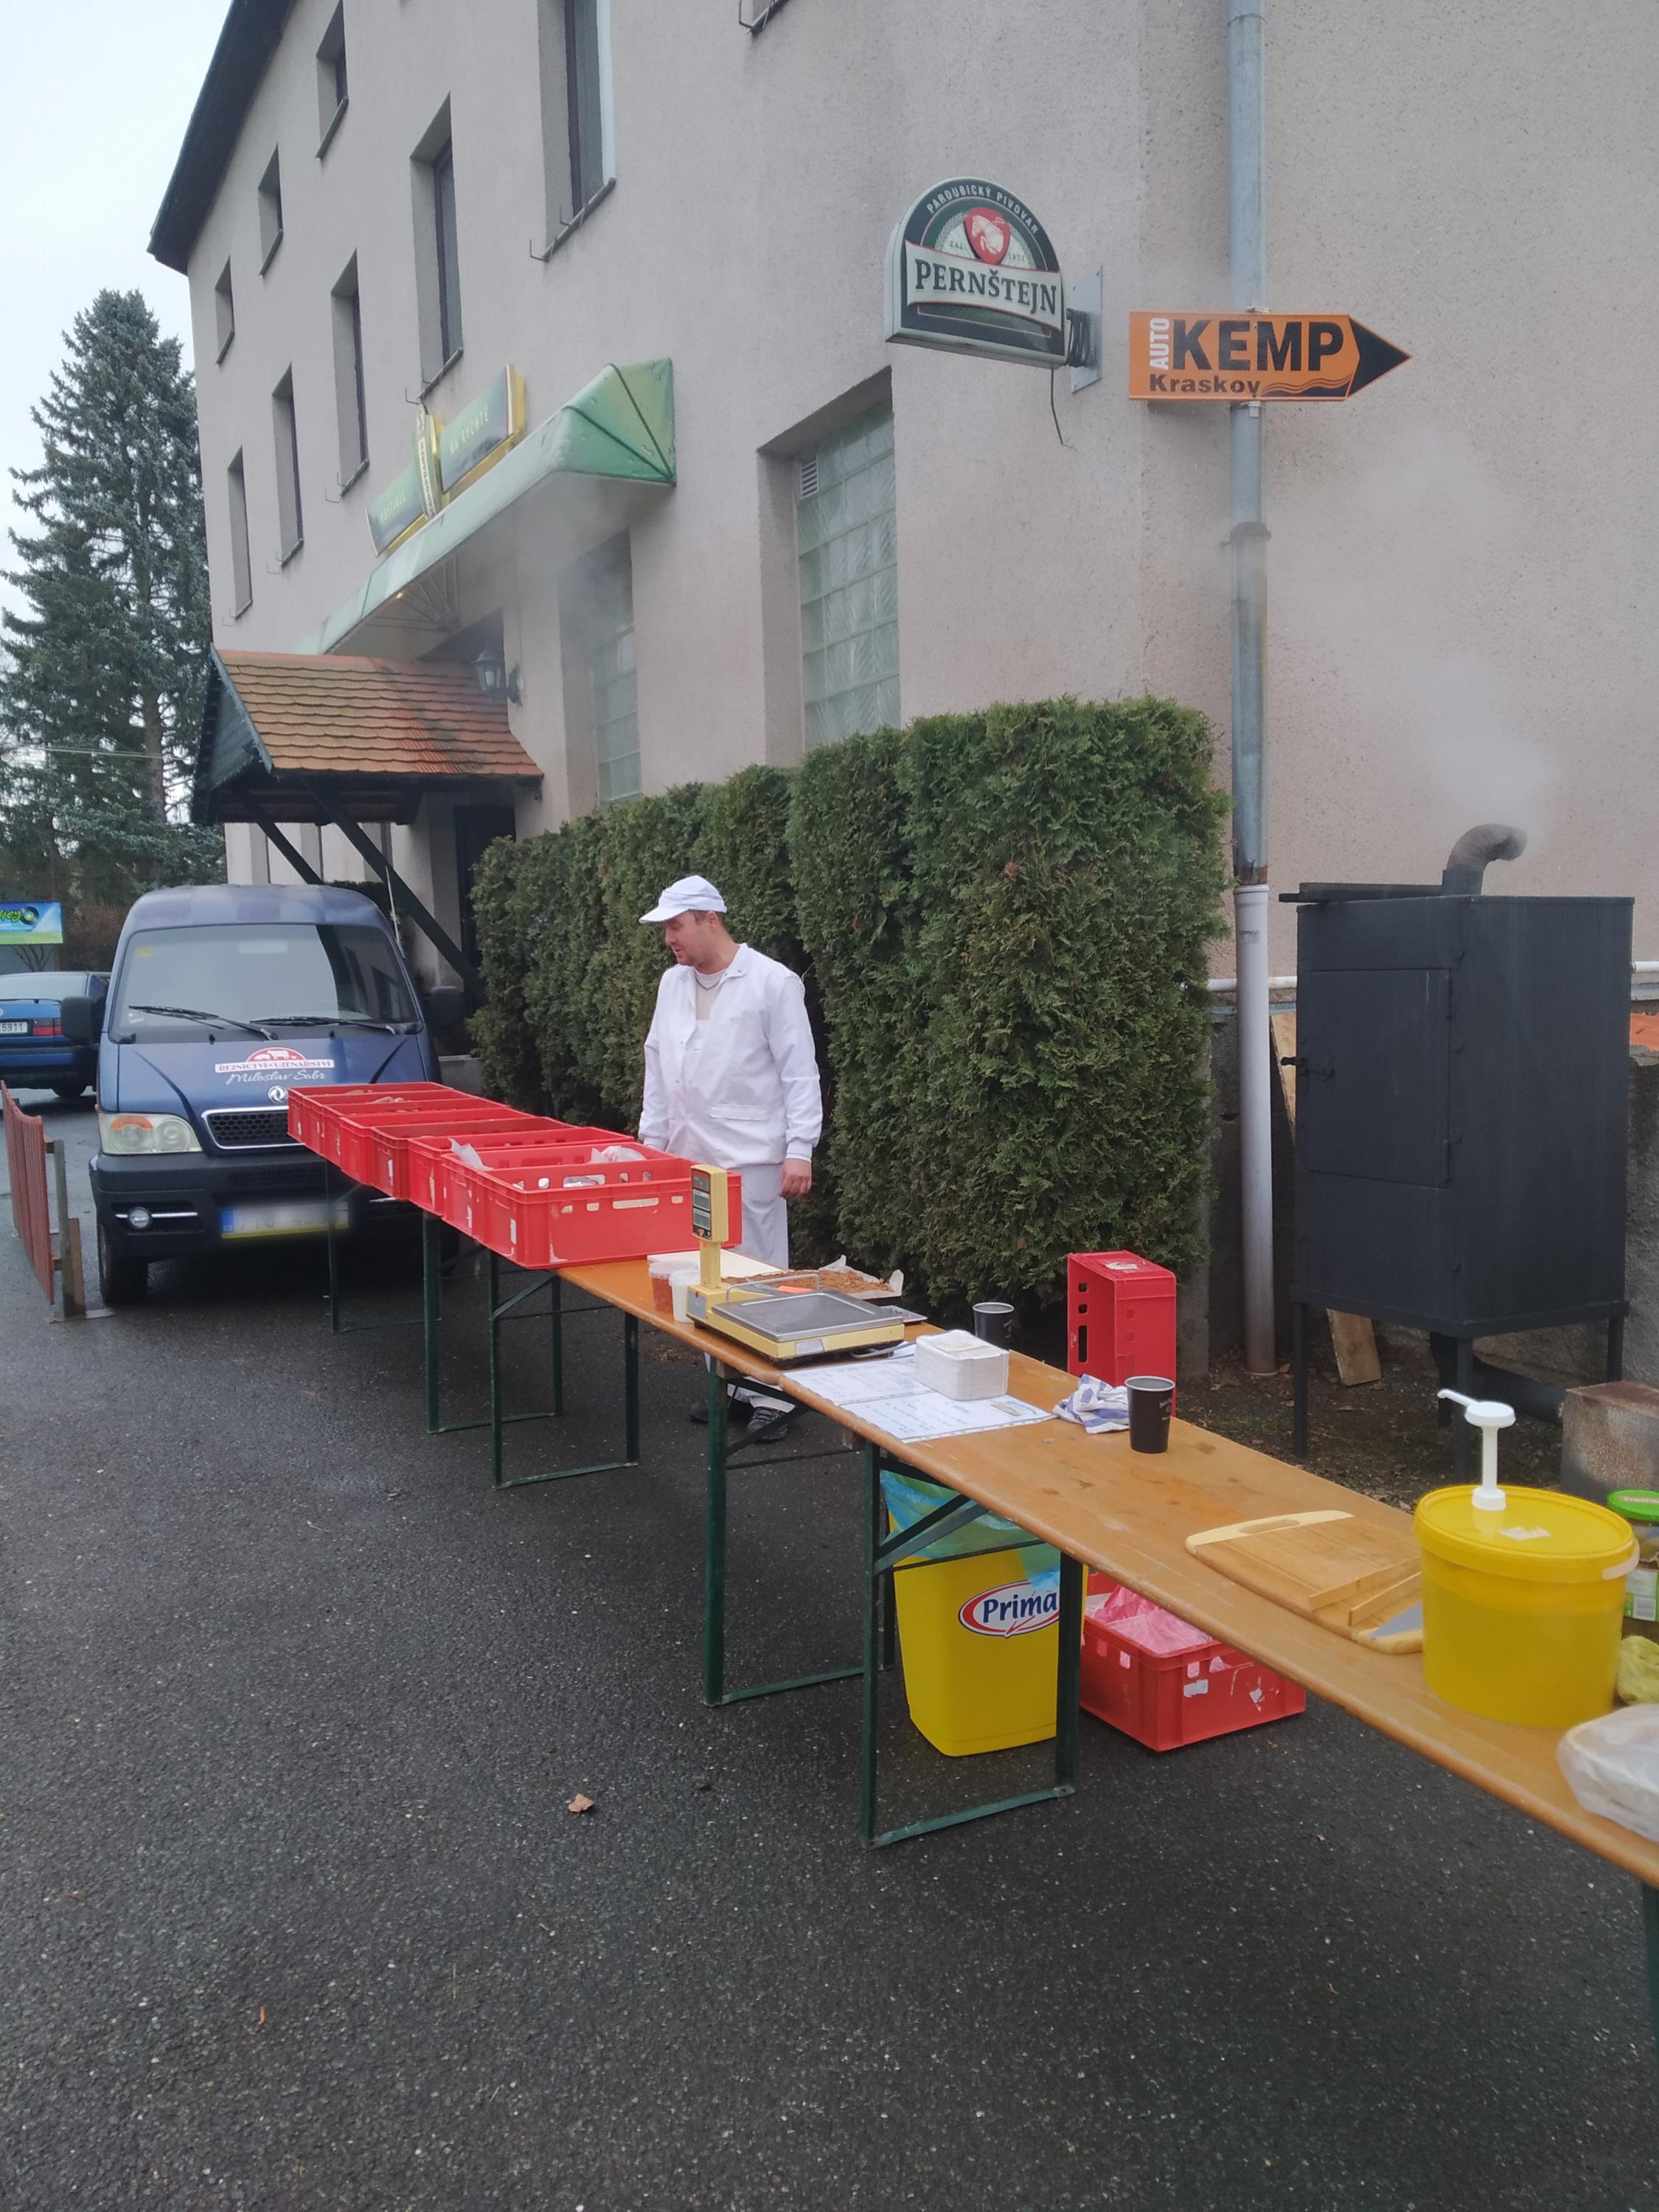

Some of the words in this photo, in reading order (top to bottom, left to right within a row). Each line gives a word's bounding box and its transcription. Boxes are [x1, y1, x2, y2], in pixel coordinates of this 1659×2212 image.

[996, 192, 1038, 234] PIVOVAR
[914, 259, 1057, 315] PERNŠTEJN
[1150, 317, 1170, 369] AUTO
[1172, 319, 1344, 372] KEMP
[1149, 374, 1262, 394] Kraskov
[1, 1023, 22, 1032] 5911
[983, 1592, 1057, 1624] Prima
